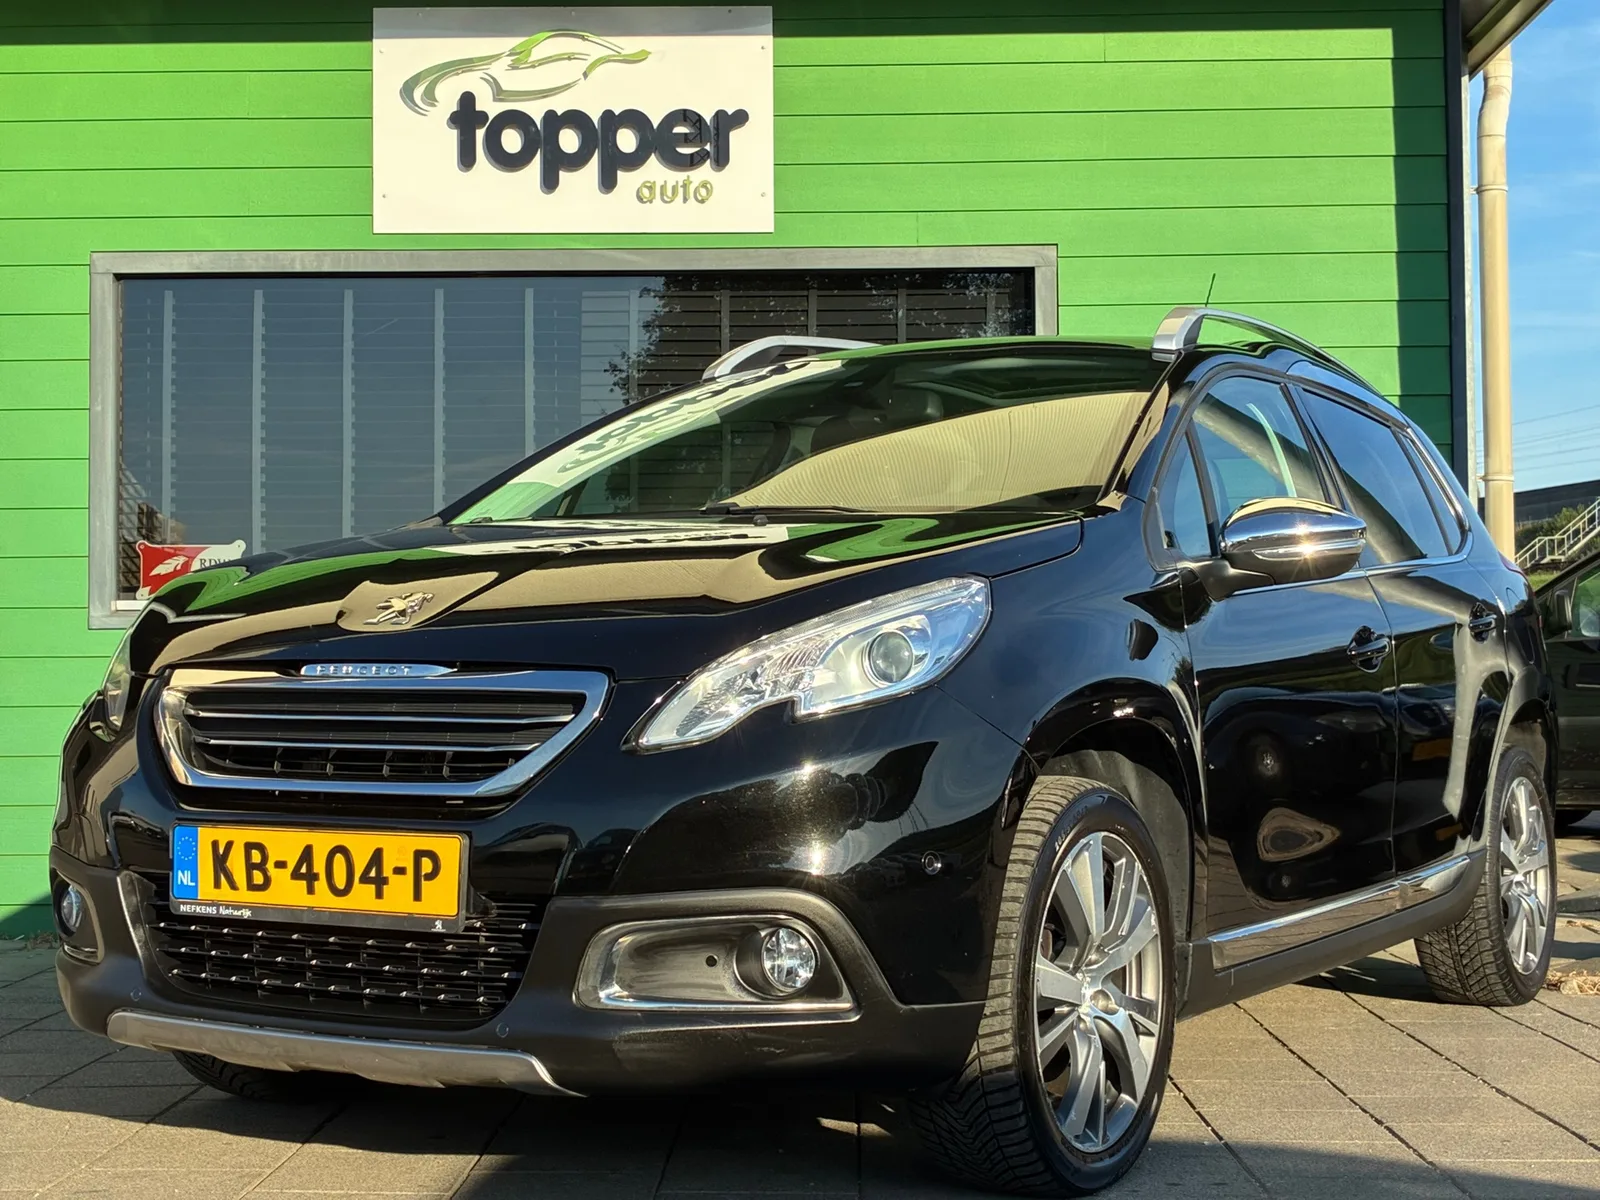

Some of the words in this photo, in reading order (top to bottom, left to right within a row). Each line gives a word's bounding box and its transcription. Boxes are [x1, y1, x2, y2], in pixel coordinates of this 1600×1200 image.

[447, 90, 750, 195] topper
[636, 174, 713, 204] auto
[316, 665, 412, 675] PEUGEOT
[177, 869, 196, 887] NL
[210, 839, 442, 902] KB-404-P
[180, 904, 217, 915] NEFKENS
